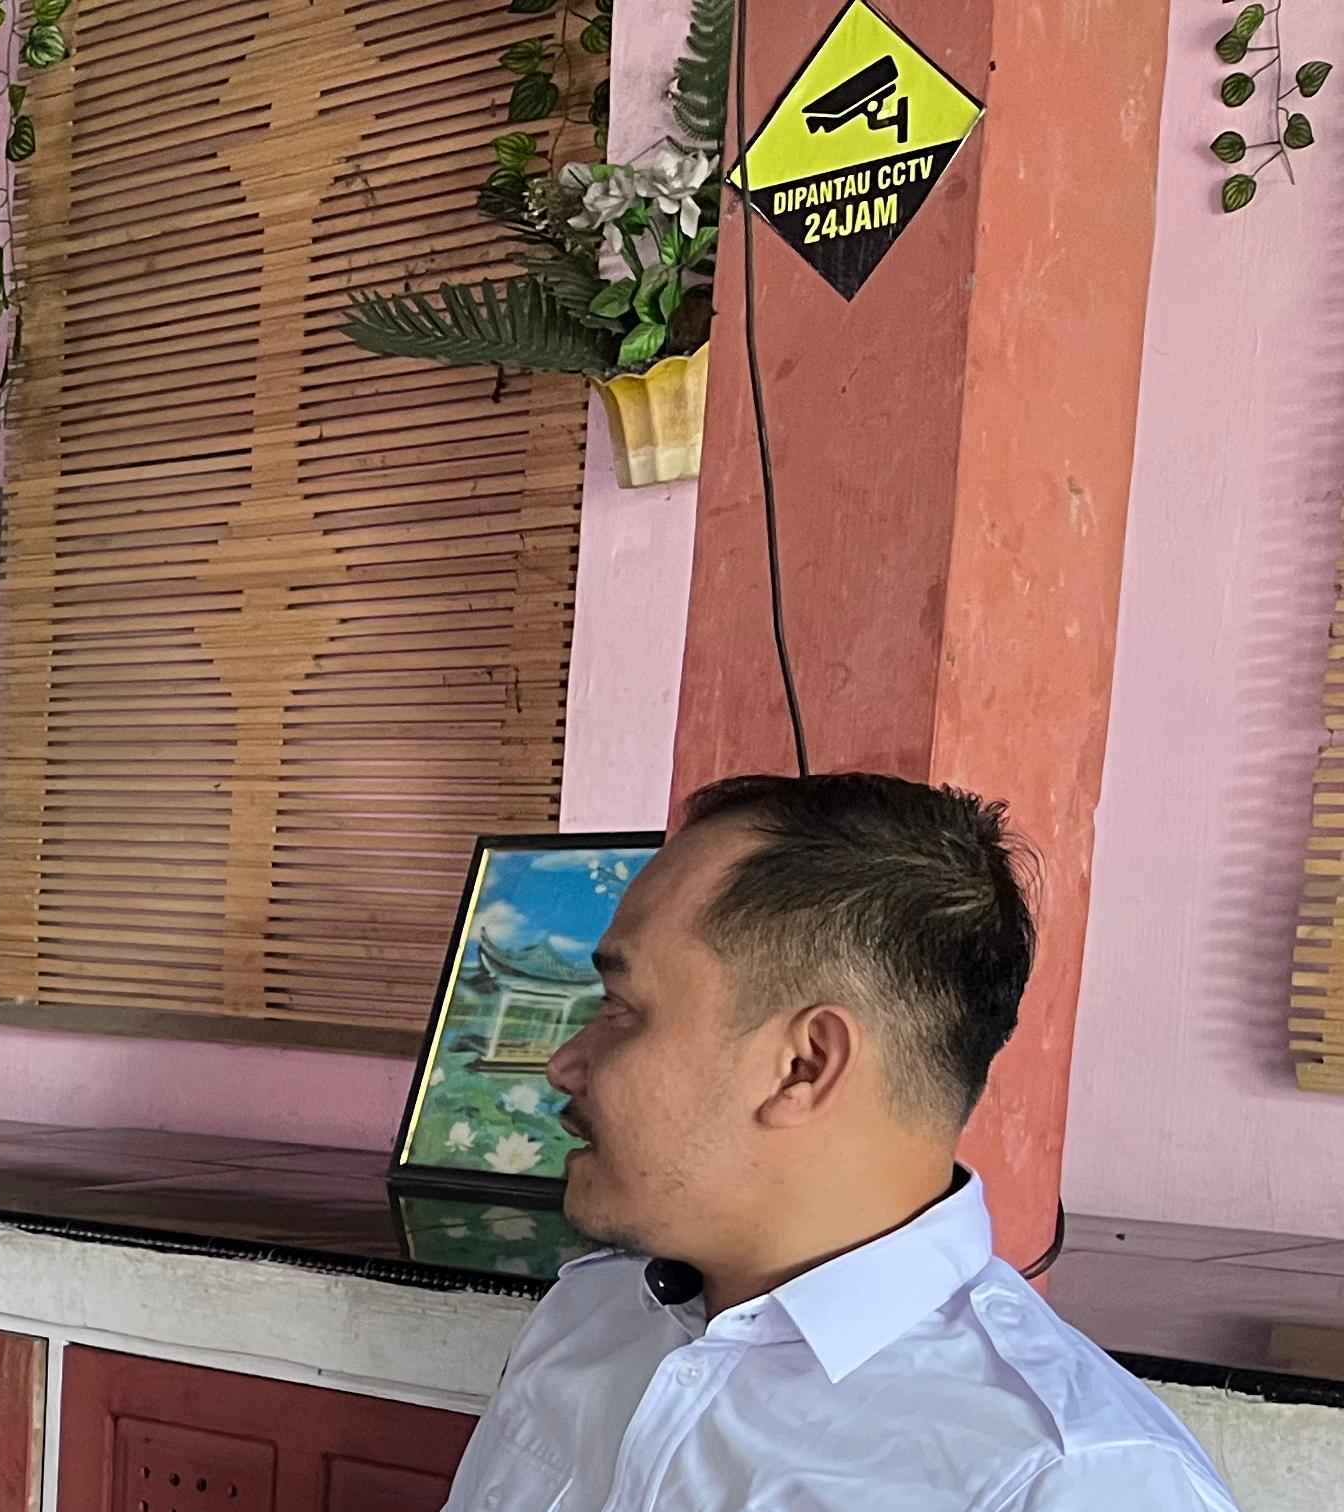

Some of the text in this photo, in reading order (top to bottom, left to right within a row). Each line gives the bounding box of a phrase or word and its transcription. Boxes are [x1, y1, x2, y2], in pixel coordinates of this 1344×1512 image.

[773, 155, 934, 215] DIPANTAU CCTV
[804, 193, 898, 244] 24JAM
